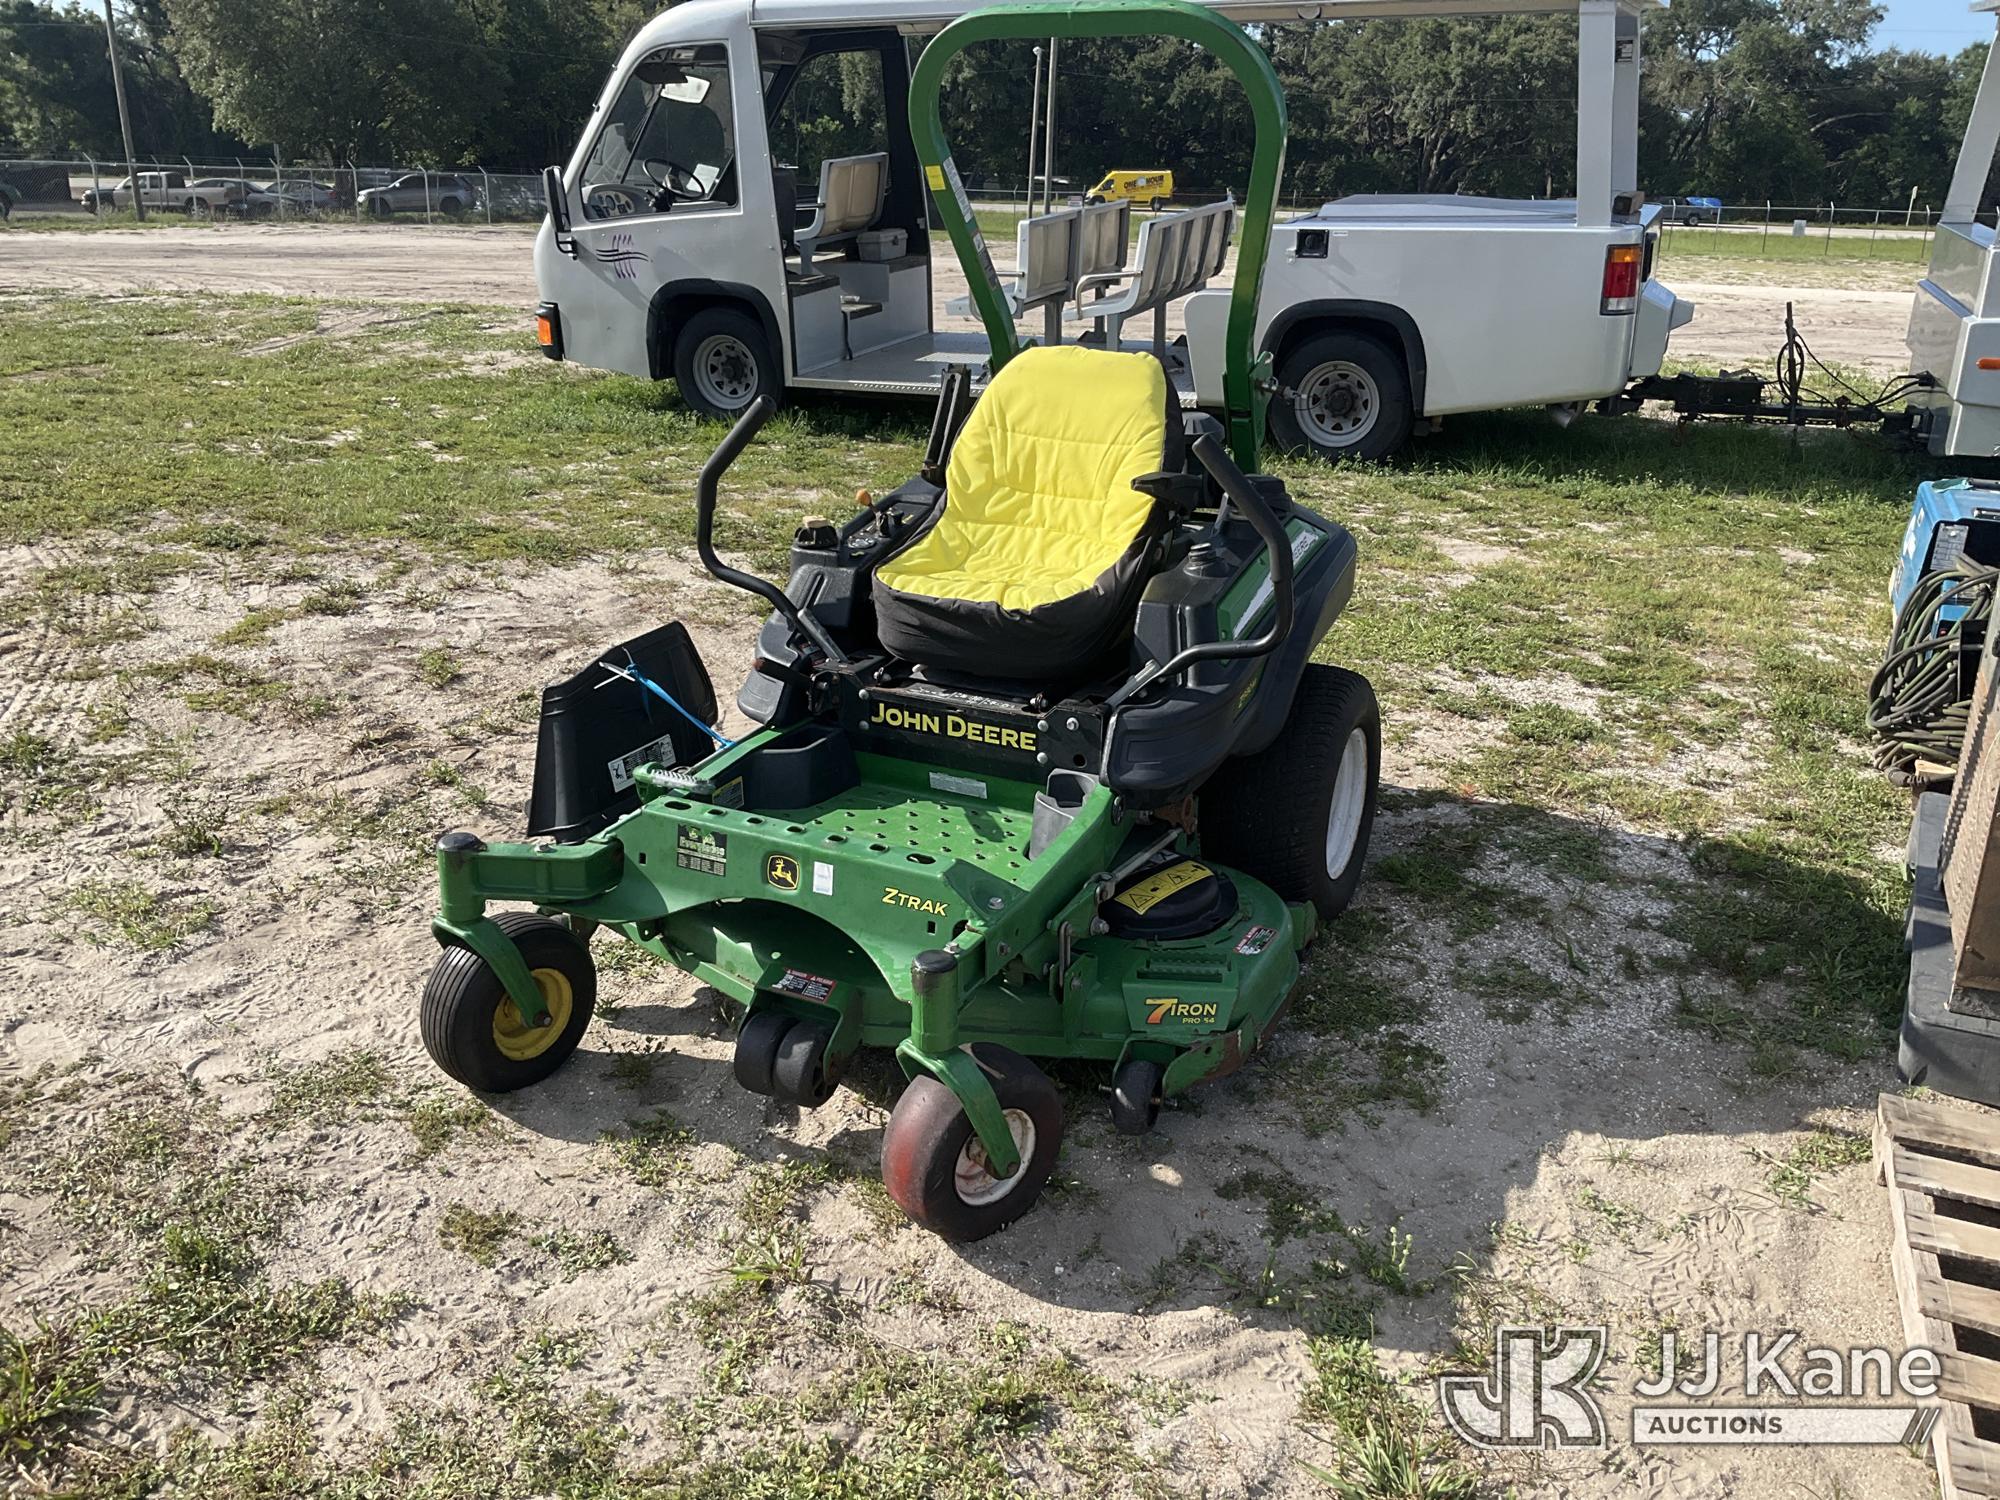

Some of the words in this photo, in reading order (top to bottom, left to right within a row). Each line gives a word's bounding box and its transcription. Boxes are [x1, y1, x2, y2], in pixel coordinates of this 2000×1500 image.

[871, 703, 940, 734] JOHN
[947, 715, 1037, 751] DEERE
[882, 887, 949, 916] ZTRAK
